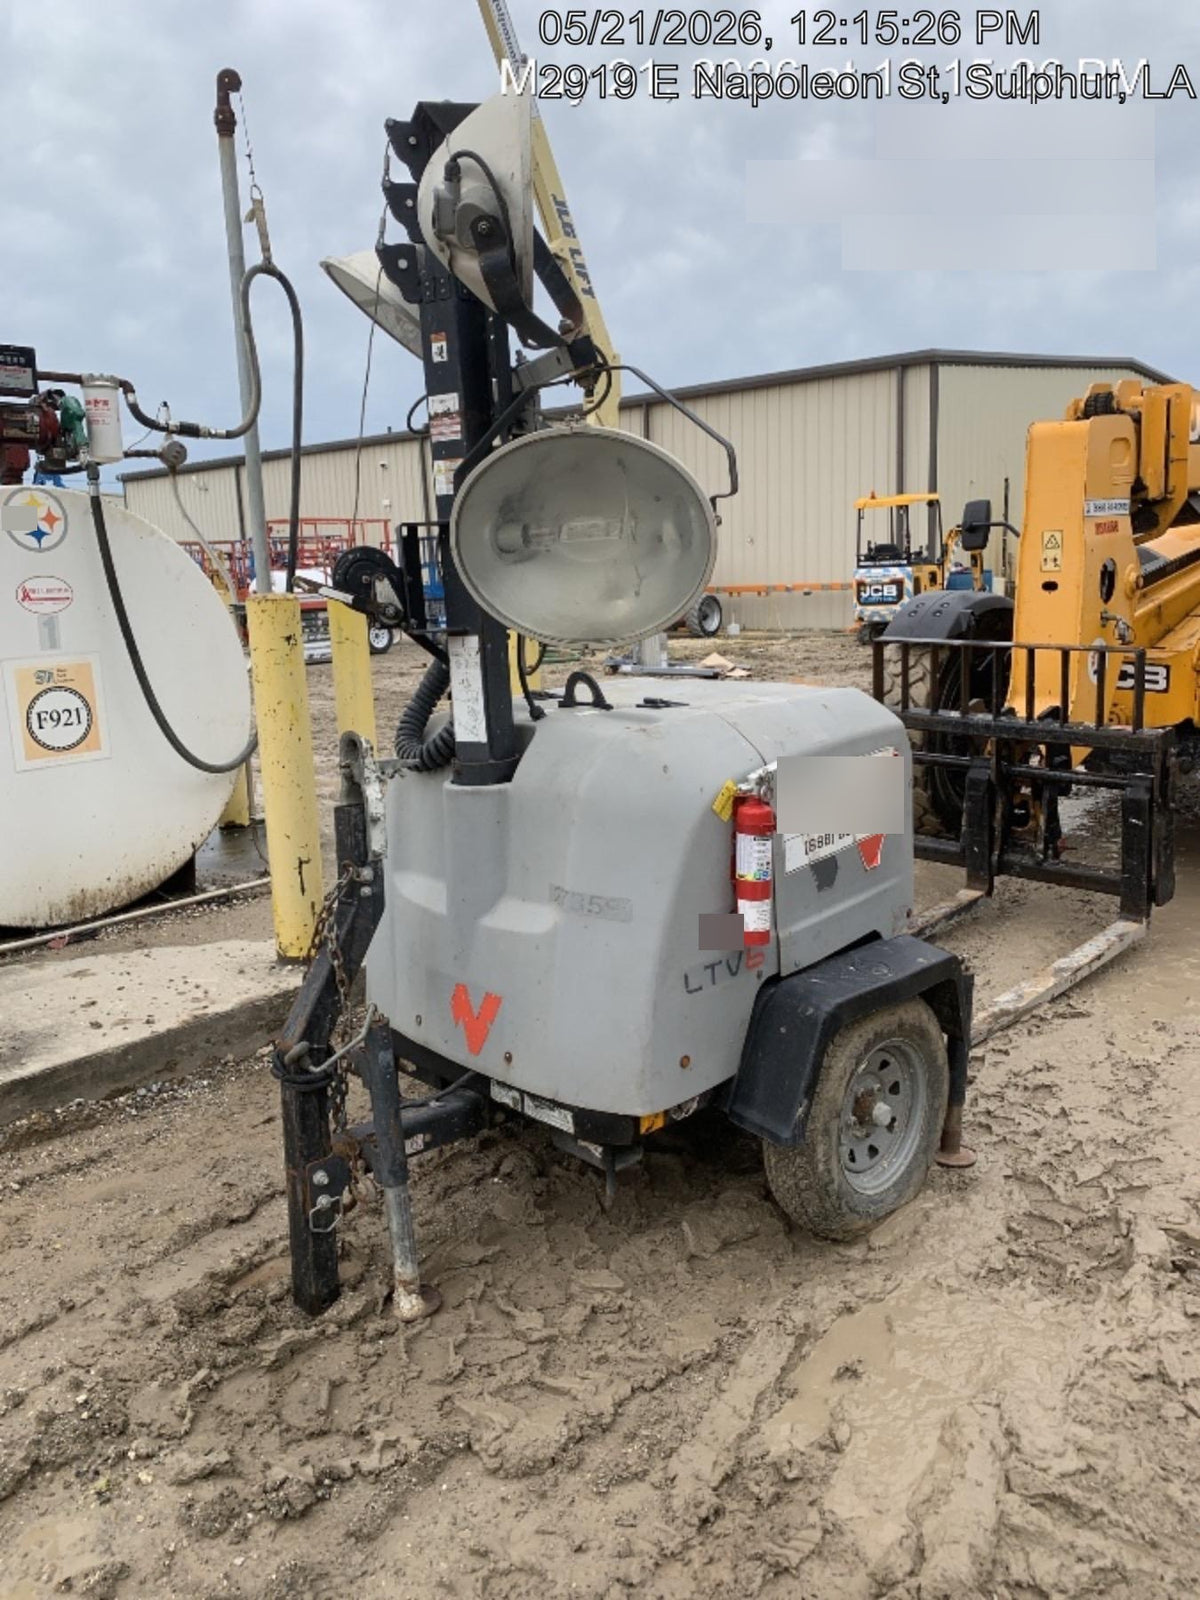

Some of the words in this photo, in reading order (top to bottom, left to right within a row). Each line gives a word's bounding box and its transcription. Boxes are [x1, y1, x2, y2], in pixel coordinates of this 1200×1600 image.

[550, 193, 577, 239] JLG
[569, 247, 596, 300] LIFT
[860, 584, 897, 598] JCB
[1116, 663, 1168, 691] CB
[36, 707, 83, 730] F921
